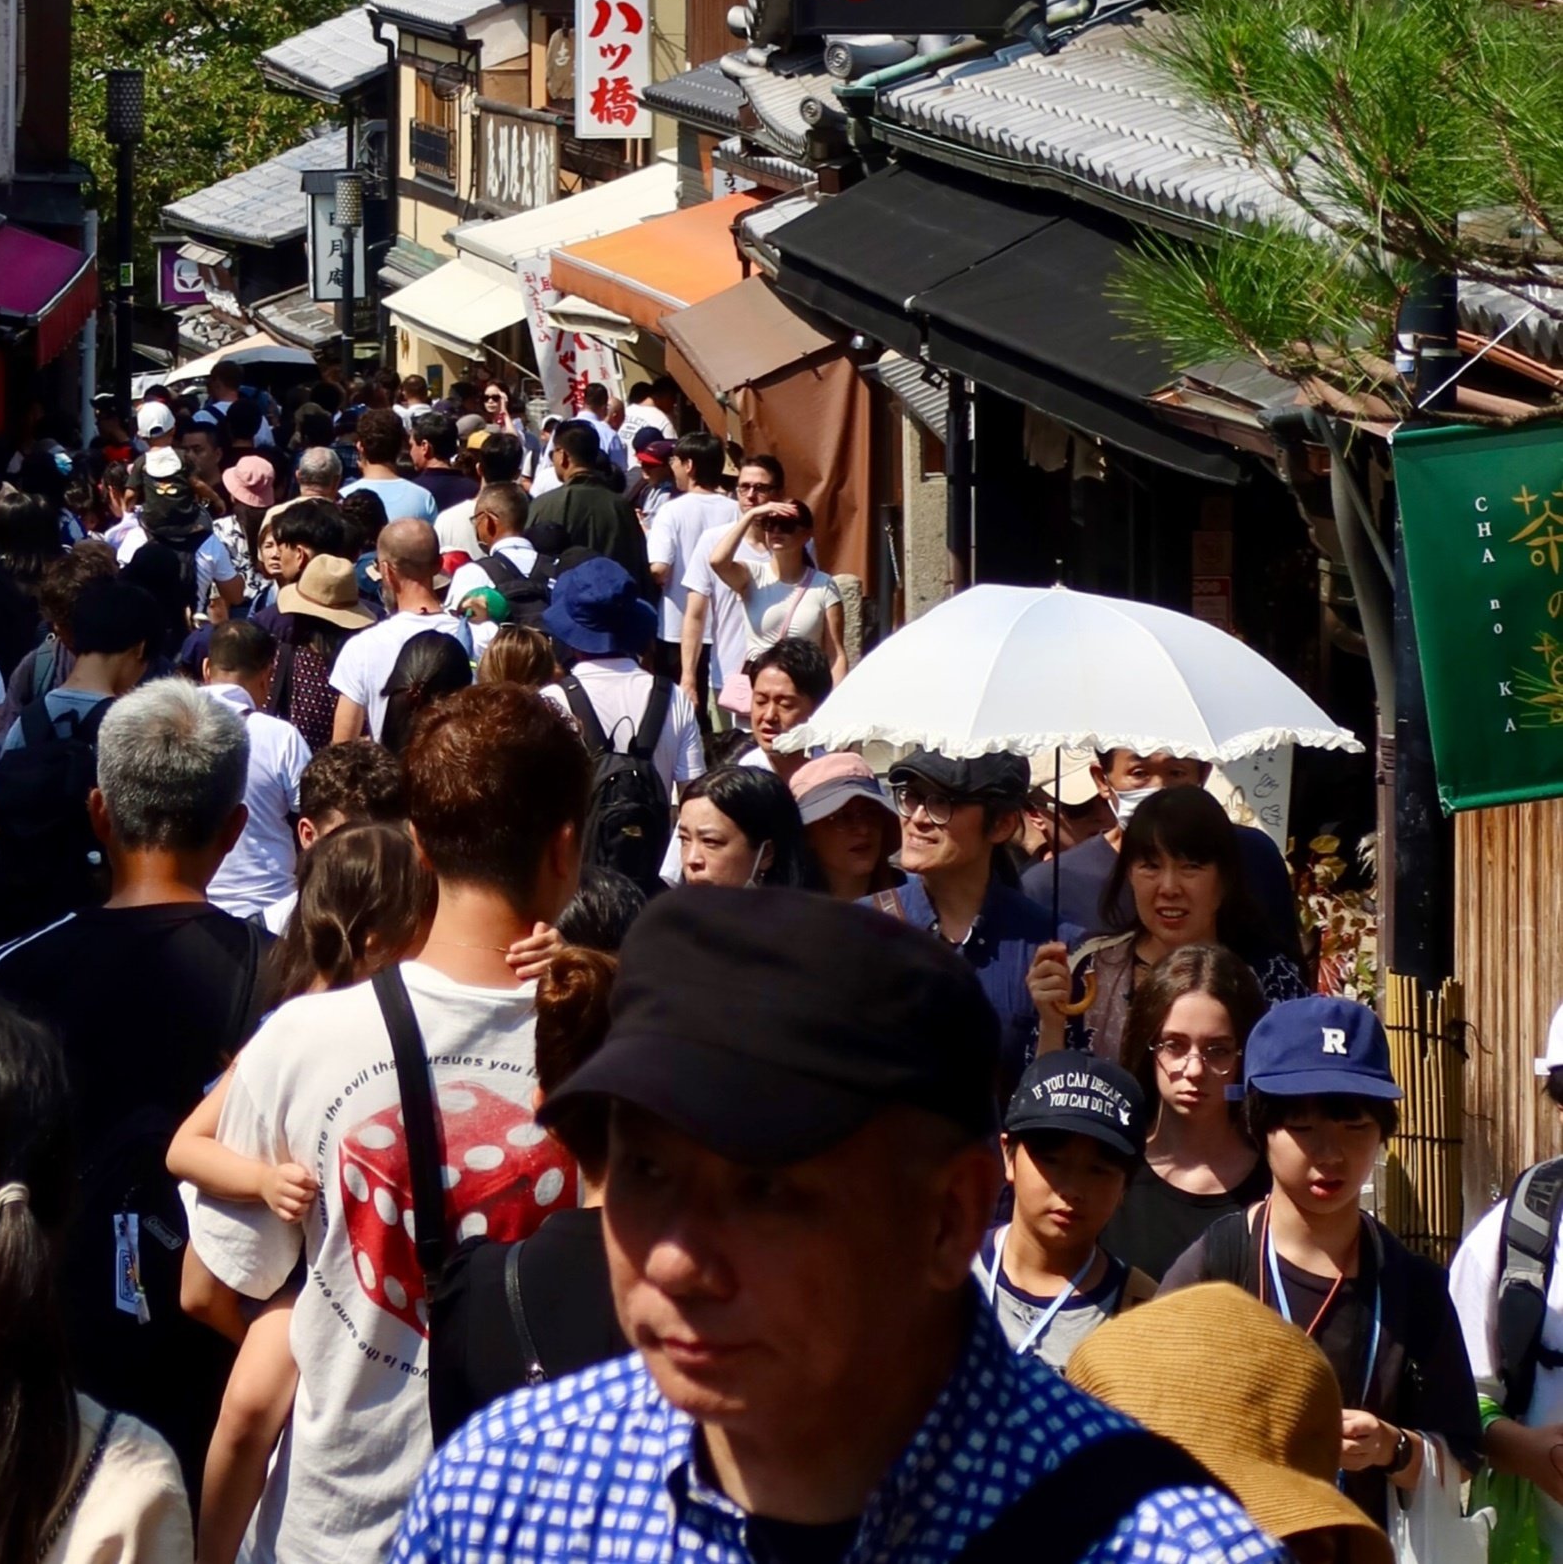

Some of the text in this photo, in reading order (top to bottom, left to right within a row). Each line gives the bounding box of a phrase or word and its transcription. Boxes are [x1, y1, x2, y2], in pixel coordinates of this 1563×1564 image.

[1321, 1026, 1349, 1056] R
[325, 1096, 344, 1122] the
[344, 1069, 370, 1097] evil
[372, 1058, 397, 1076] tha
[426, 1055, 484, 1068] ursues
[489, 1058, 523, 1076] you
[1031, 1085, 1043, 1101] IF
[1043, 1074, 1065, 1094] YOU
[1066, 1072, 1089, 1089] CAN
[1089, 1076, 1123, 1105] DREAM
[1049, 1093, 1069, 1107] YOU
[1069, 1093, 1089, 1110] CAN
[1090, 1096, 1104, 1113] DO
[357, 1340, 381, 1361] the
[382, 1354, 398, 1368] is
